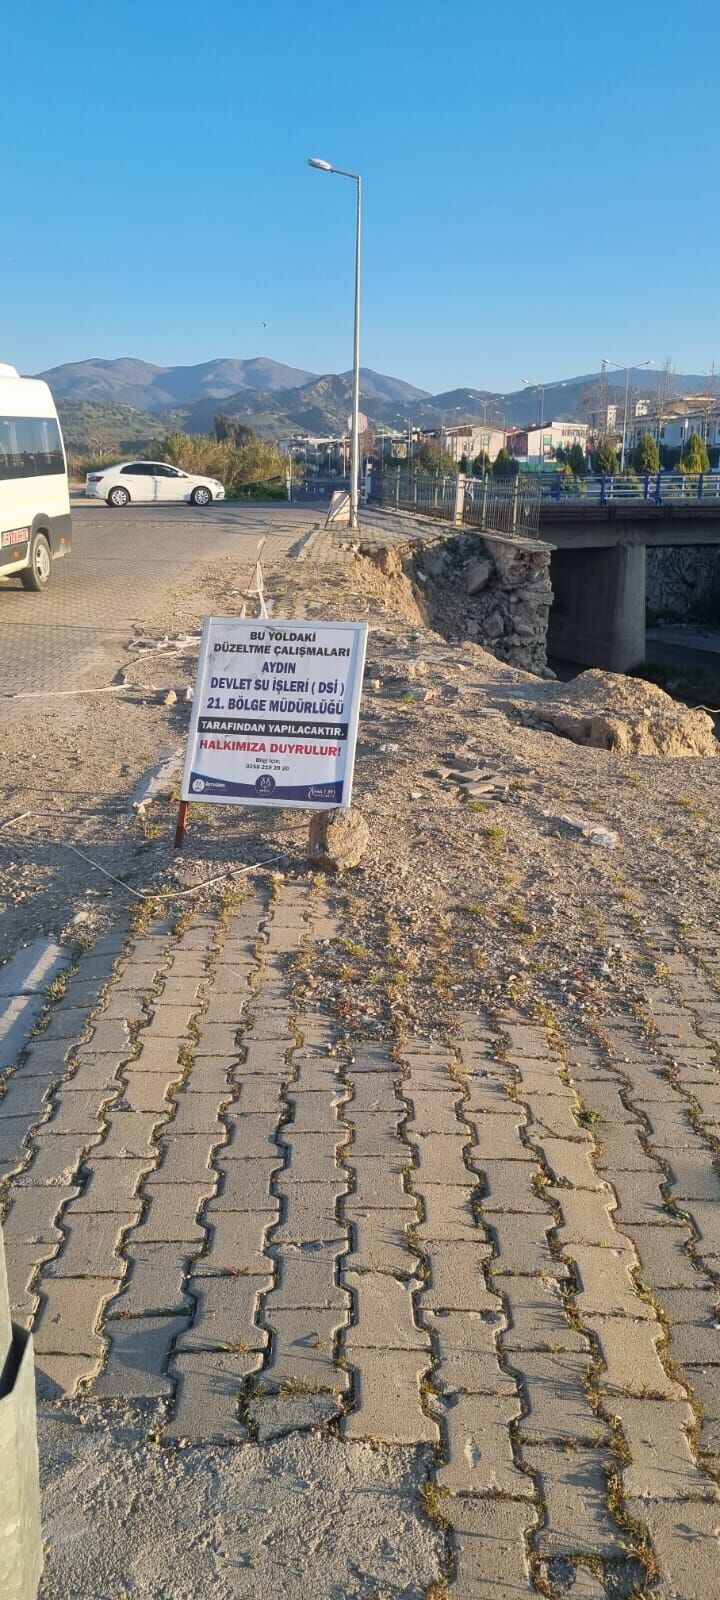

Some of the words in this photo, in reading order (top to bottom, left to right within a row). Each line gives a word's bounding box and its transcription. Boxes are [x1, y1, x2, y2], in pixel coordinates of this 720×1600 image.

[250, 632, 265, 641] BU
[268, 631, 316, 642] YOLDAKİ
[213, 642, 271, 654] DÜZELTME
[274, 645, 350, 658] ÇALIŞMALARI
[261, 661, 296, 674] AYDIN
[210, 677, 253, 690] DEVLET
[254, 679, 269, 691] SU
[272, 677, 309, 695] İŞLERİ
[318, 679, 338, 694] DSİ
[206, 697, 224, 710] 21.
[228, 695, 266, 712] BÖLGE
[269, 697, 344, 715] MÜDÜRLÜĞÜ
[201, 720, 266, 732] TARAFINDAN
[267, 723, 345, 736] YAPILACAKTIR.
[199, 740, 266, 753] HALKIMIZA
[269, 742, 342, 757] DUYRULUR!
